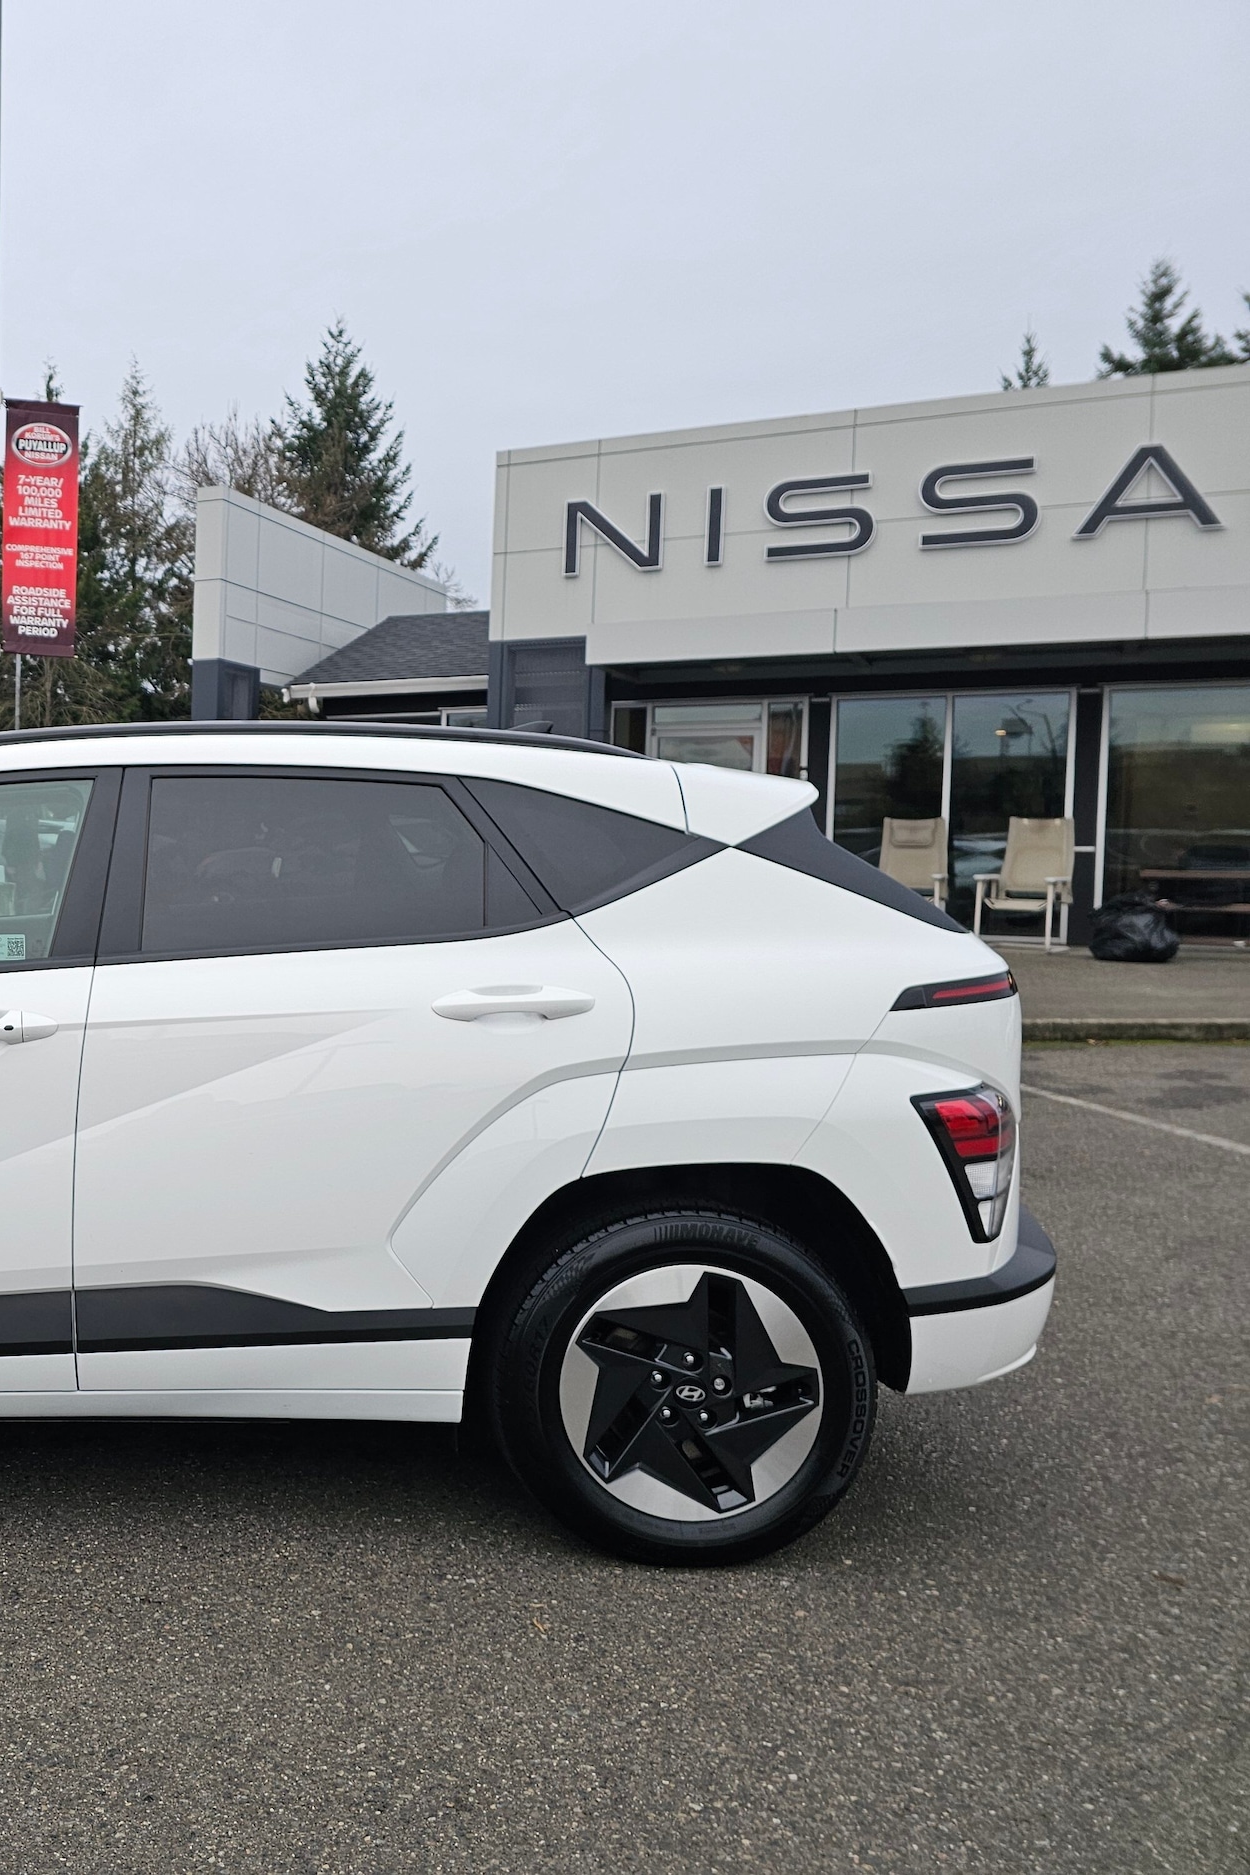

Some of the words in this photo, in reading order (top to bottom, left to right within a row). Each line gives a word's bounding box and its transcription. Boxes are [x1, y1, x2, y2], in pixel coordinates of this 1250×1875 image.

[25, 431, 60, 442] KORUM'S
[18, 439, 67, 453] PUYALLUP
[24, 451, 58, 460] NISSAN
[18, 475, 64, 486] 7-YEAR/
[17, 485, 62, 497] 100,000
[24, 497, 58, 508] MILES
[18, 507, 62, 518] LIMITED
[564, 443, 1223, 577] NISSA
[9, 517, 71, 530] WARRANTY
[6, 544, 74, 556] COMPREHENSIVE
[15, 560, 63, 568] INSPECTION
[12, 586, 66, 598] ROADSIDE
[7, 596, 71, 608] ASSISTANCE
[14, 606, 36, 615] FOR
[38, 608, 62, 618] FULL
[9, 616, 68, 628] WARRANTY
[18, 626, 58, 638] PERIOD
[836, 1338, 868, 1478] CROSSOVER
